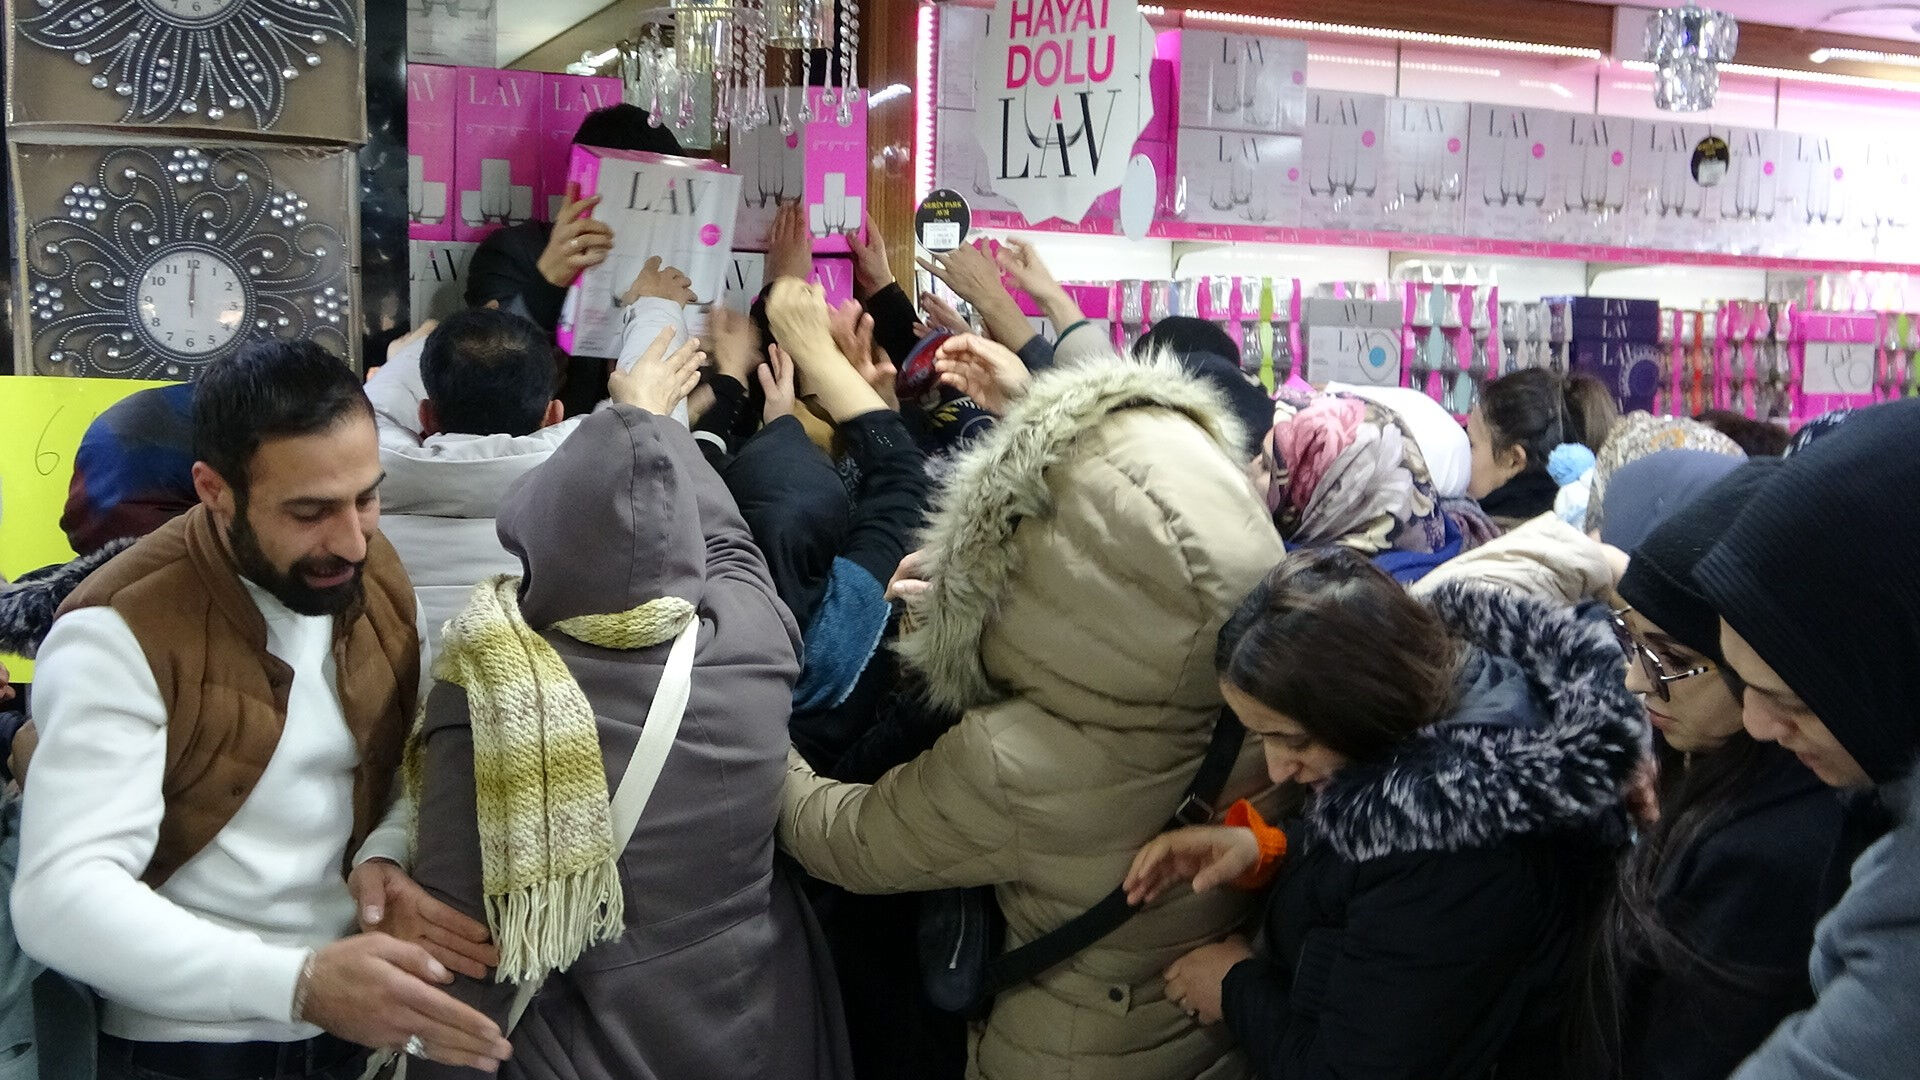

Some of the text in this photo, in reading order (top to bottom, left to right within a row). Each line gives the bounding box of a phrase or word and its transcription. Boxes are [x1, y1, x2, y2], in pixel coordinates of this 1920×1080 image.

[192, 2, 201, 12] 6
[1006, 35, 1116, 89] DOLU
[469, 75, 528, 107] LAV
[554, 81, 611, 112] LAV
[996, 89, 1121, 180] LAV
[625, 171, 713, 215] LAV
[166, 265, 178, 274] 11
[187, 260, 200, 270] 12
[409, 248, 466, 282] AV
[213, 267, 218, 276] 1
[152, 276, 166, 286] 10
[225, 281, 233, 291] 2
[230, 301, 238, 311] 3
[152, 317, 160, 327] 8
[166, 331, 174, 341] 7
[208, 334, 216, 345] 5
[186, 337, 195, 348] 6
